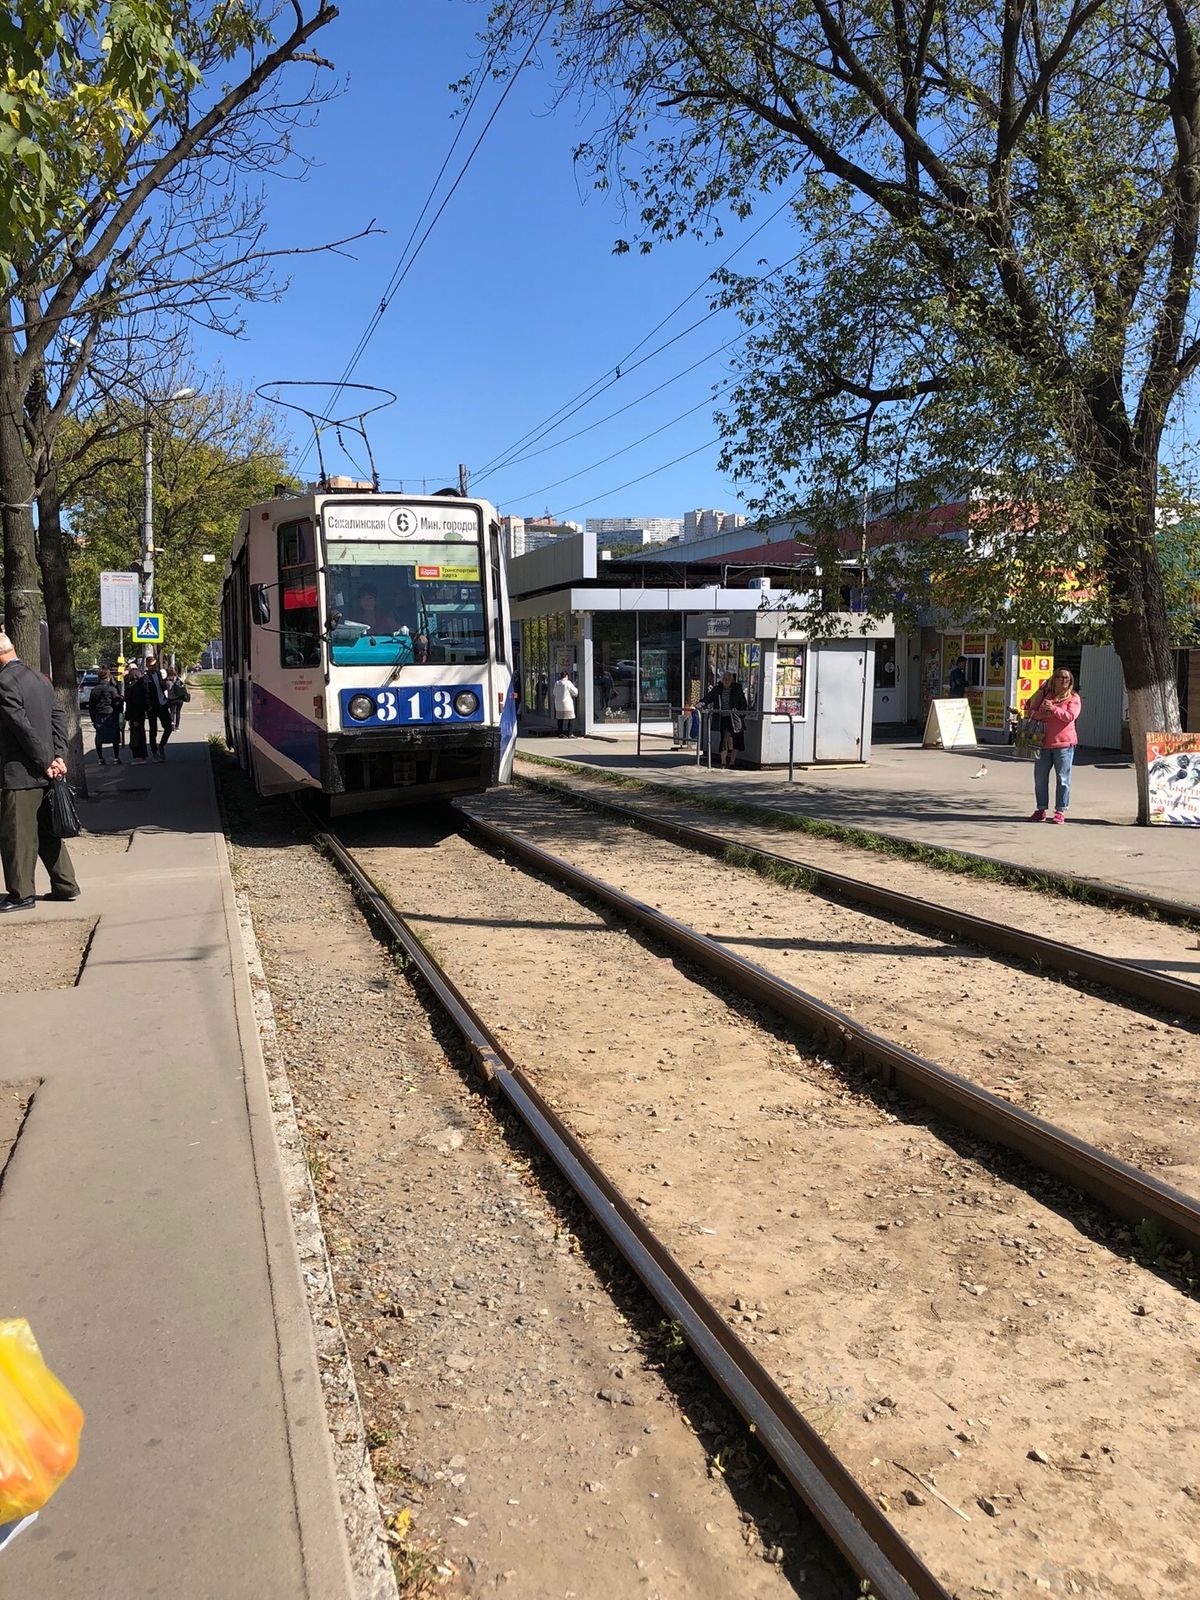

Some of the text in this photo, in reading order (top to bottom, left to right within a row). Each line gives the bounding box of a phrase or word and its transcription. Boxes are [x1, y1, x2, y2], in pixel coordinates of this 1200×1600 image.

[327, 513, 479, 533] Сахалинская 6 Мин. городок
[377, 691, 452, 721] 313
